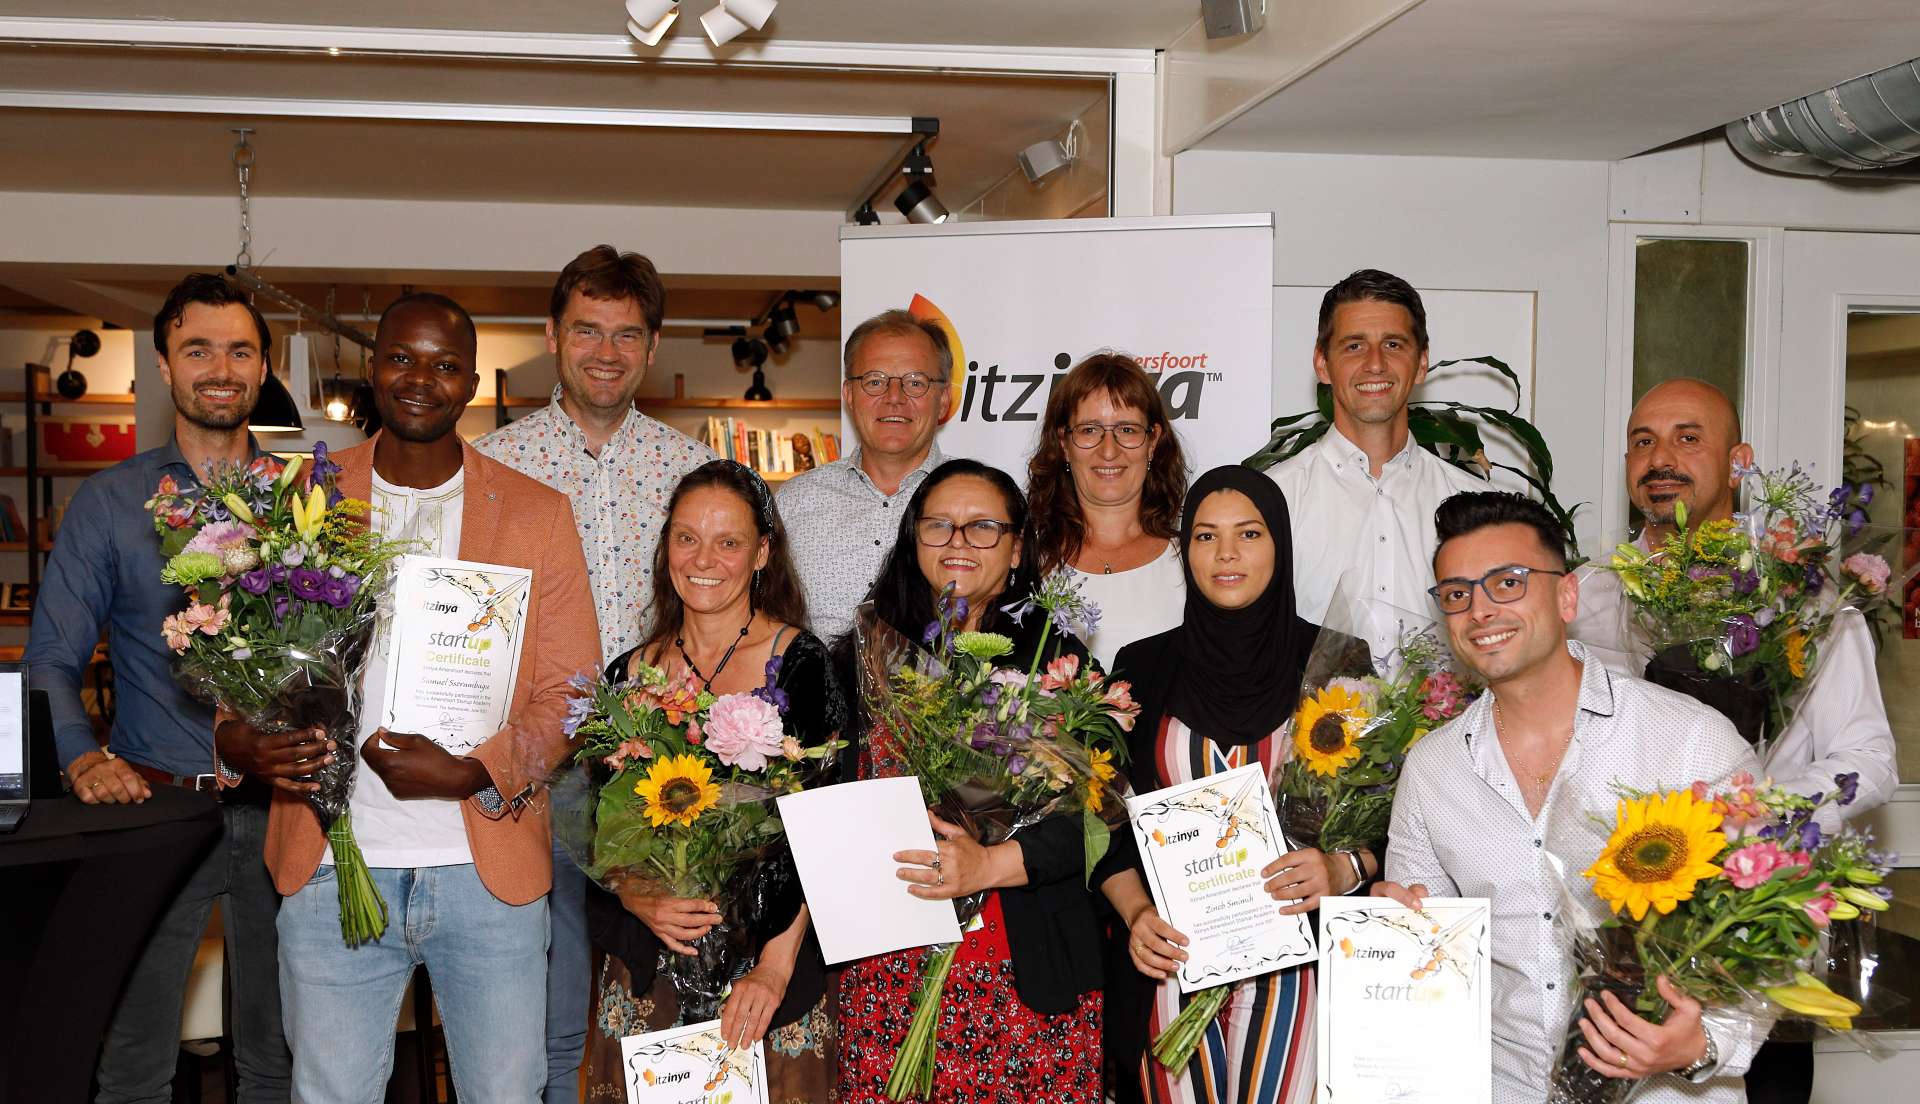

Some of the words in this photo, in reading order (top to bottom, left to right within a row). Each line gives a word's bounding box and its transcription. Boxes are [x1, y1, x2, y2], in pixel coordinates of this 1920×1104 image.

[1134, 352, 1208, 373] ersfoort
[427, 631, 493, 655] startup
[426, 650, 491, 668] Certificate
[1184, 847, 1249, 877] startup
[1187, 867, 1256, 893] Certificate
[1362, 982, 1445, 1007] start
[655, 1071, 691, 1085] itzinya
